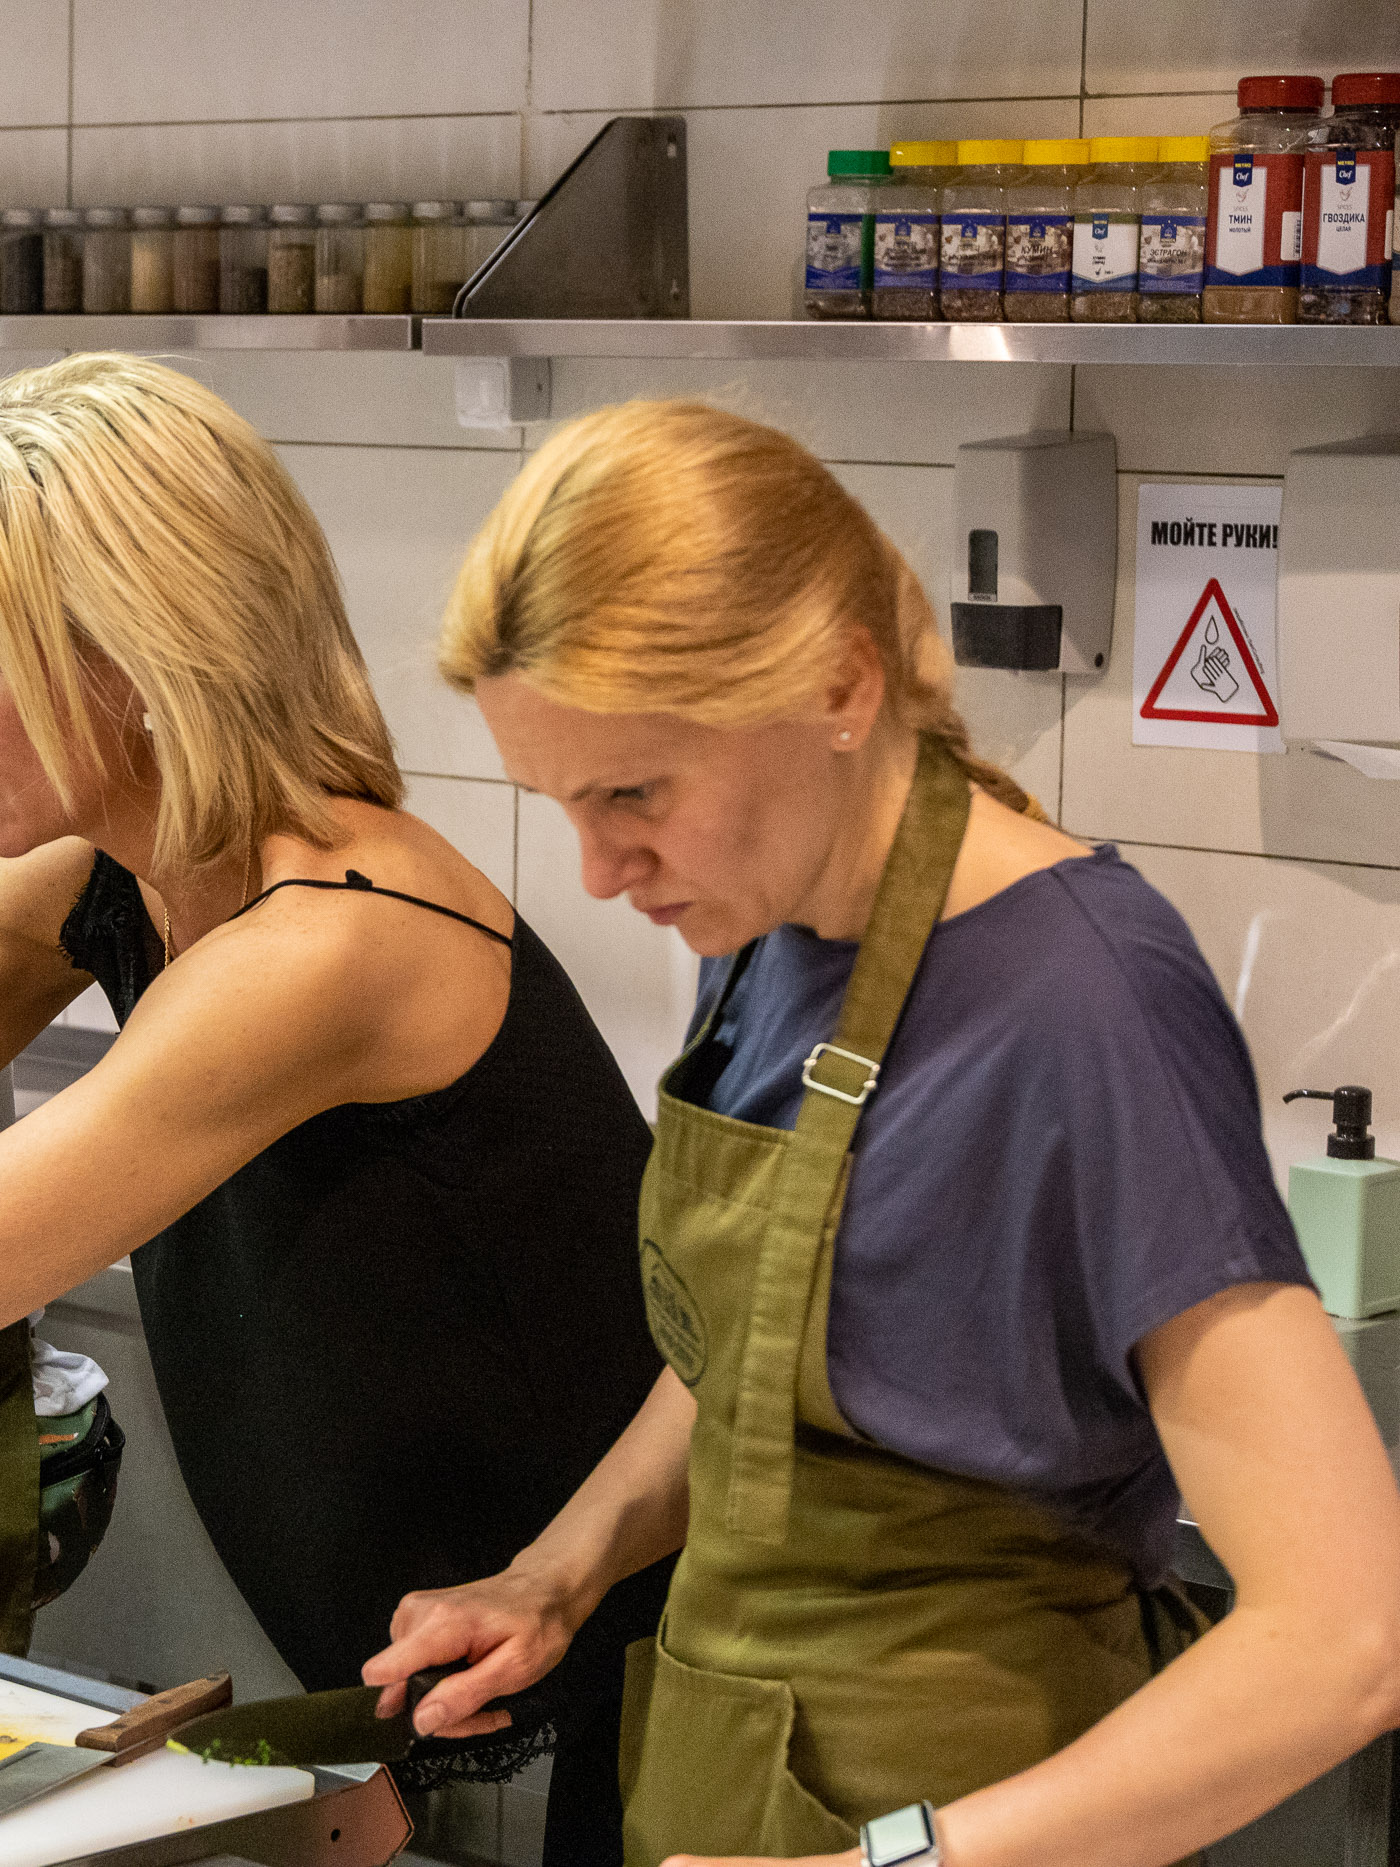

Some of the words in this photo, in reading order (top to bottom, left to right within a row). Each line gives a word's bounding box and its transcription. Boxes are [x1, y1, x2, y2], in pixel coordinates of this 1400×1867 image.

[1235, 171, 1250, 182] Chef
[1339, 169, 1353, 180] Chef
[1229, 214, 1253, 224] ТМИН
[1322, 213, 1366, 225] ГВОЗДИКА
[1151, 517, 1217, 547] МОЙТЕ
[1221, 523, 1278, 549] РУКИ!
